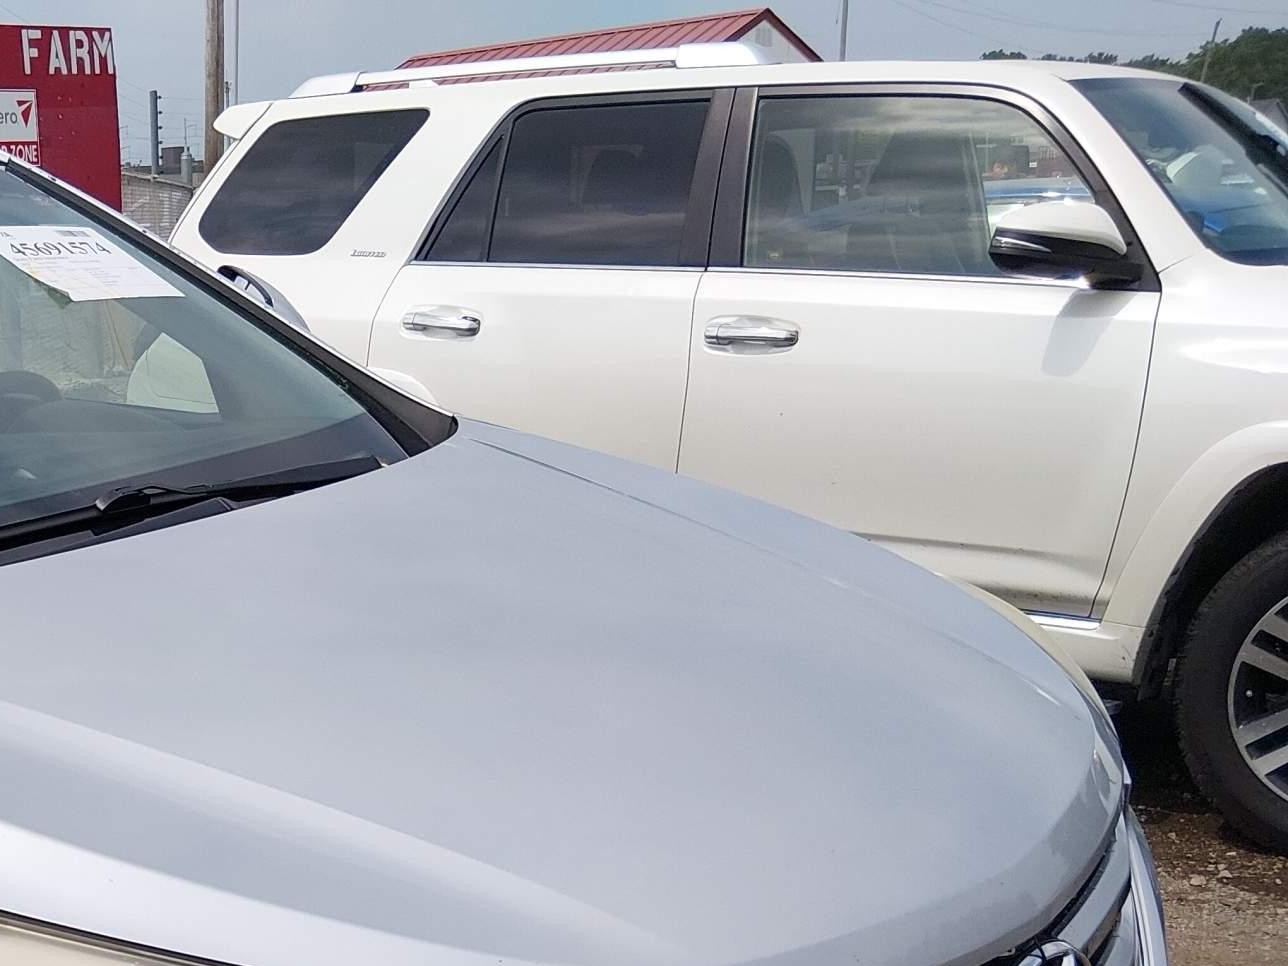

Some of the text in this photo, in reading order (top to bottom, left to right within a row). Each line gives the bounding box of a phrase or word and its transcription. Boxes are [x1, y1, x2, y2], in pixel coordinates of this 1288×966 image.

[20, 27, 116, 76] FARM
[9, 144, 38, 163] ZONE
[9, 241, 113, 257] 45691574
